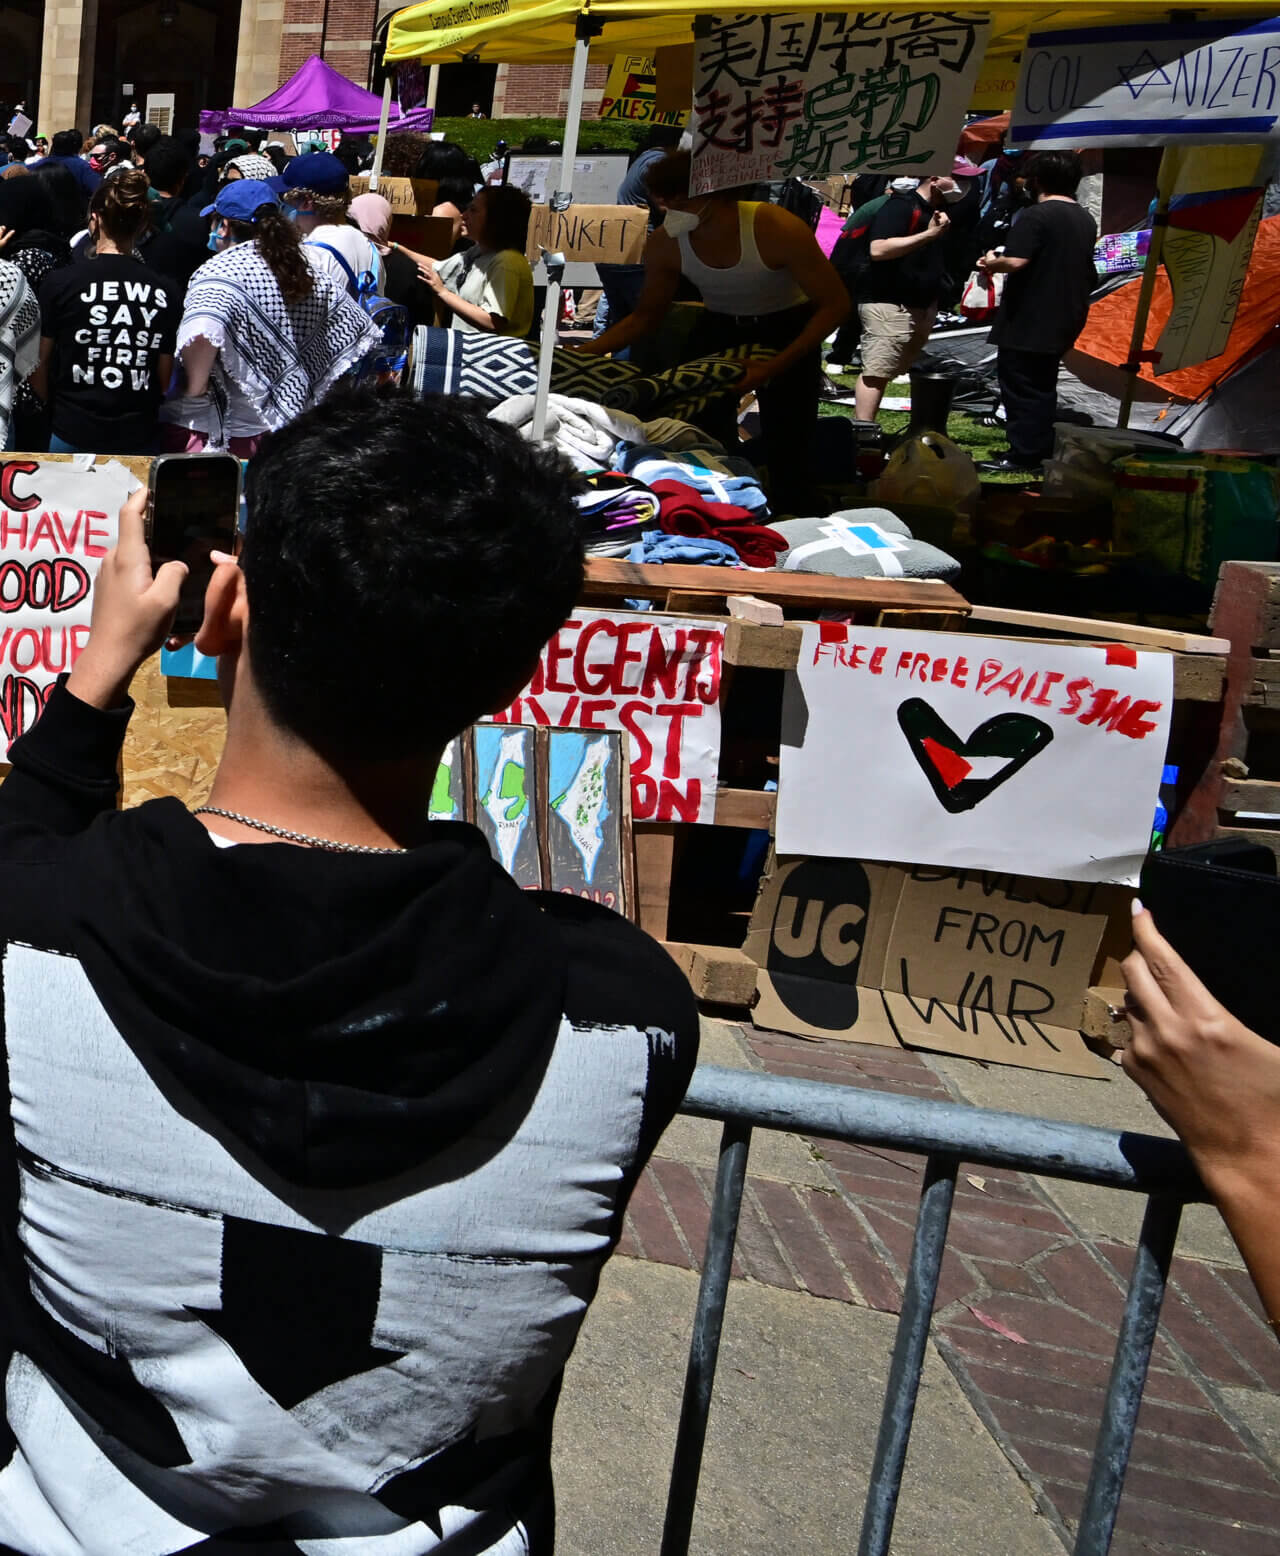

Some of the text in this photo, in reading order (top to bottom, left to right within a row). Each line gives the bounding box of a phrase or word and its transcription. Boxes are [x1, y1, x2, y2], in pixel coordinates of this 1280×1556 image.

[80, 281, 168, 308] JEWS
[89, 304, 159, 328] SAY
[74, 328, 163, 349] CEASE
[87, 346, 149, 367] FIRE
[72, 364, 151, 391] NOW
[0, 509, 110, 558] HAVE
[813, 643, 889, 674] FREE
[895, 651, 969, 688] FREE
[773, 895, 866, 967] UC
[933, 906, 1066, 967] FROM
[900, 957, 1062, 1053] WAR
[645, 1026, 675, 1060] TM
